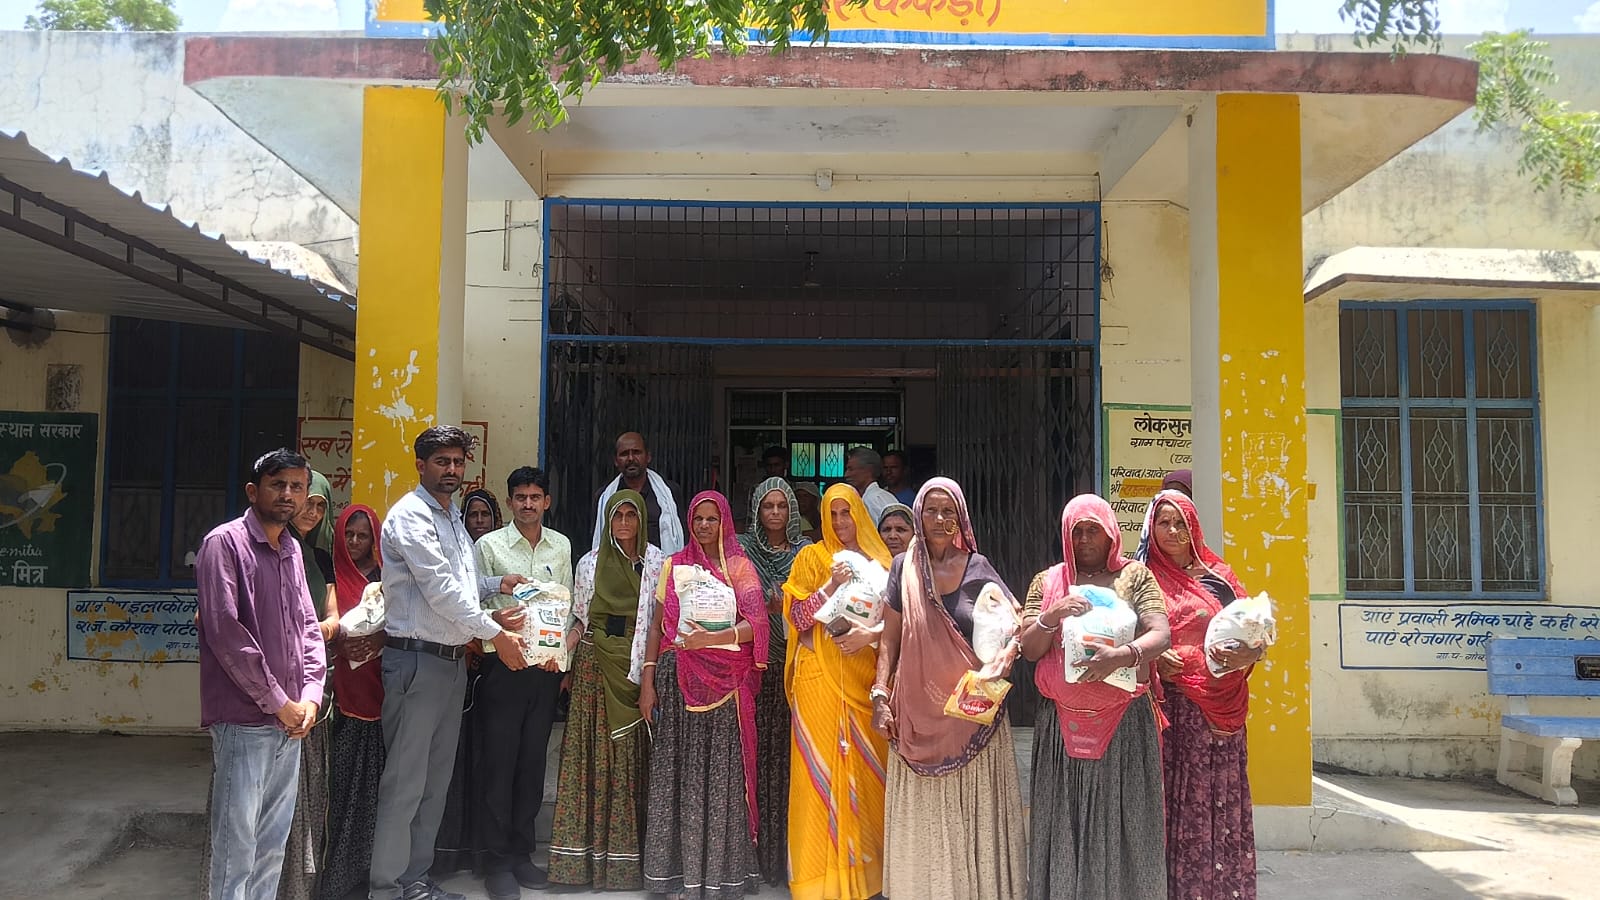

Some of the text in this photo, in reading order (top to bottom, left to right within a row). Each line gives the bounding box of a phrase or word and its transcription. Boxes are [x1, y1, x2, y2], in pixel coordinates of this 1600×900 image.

[40, 424, 83, 439] सरकार
[1130, 438, 1155, 448] ग्राम
[1110, 466, 1175, 478] परिवाद/आवेद
[1110, 481, 1121, 495] श्री
[1117, 520, 1144, 532] त्येक
[1397, 609, 1449, 627] प्रवासी
[1451, 611, 1501, 627] श्रमिक
[1502, 611, 1537, 630] चाहे
[1400, 628, 1466, 648] रोजगार
